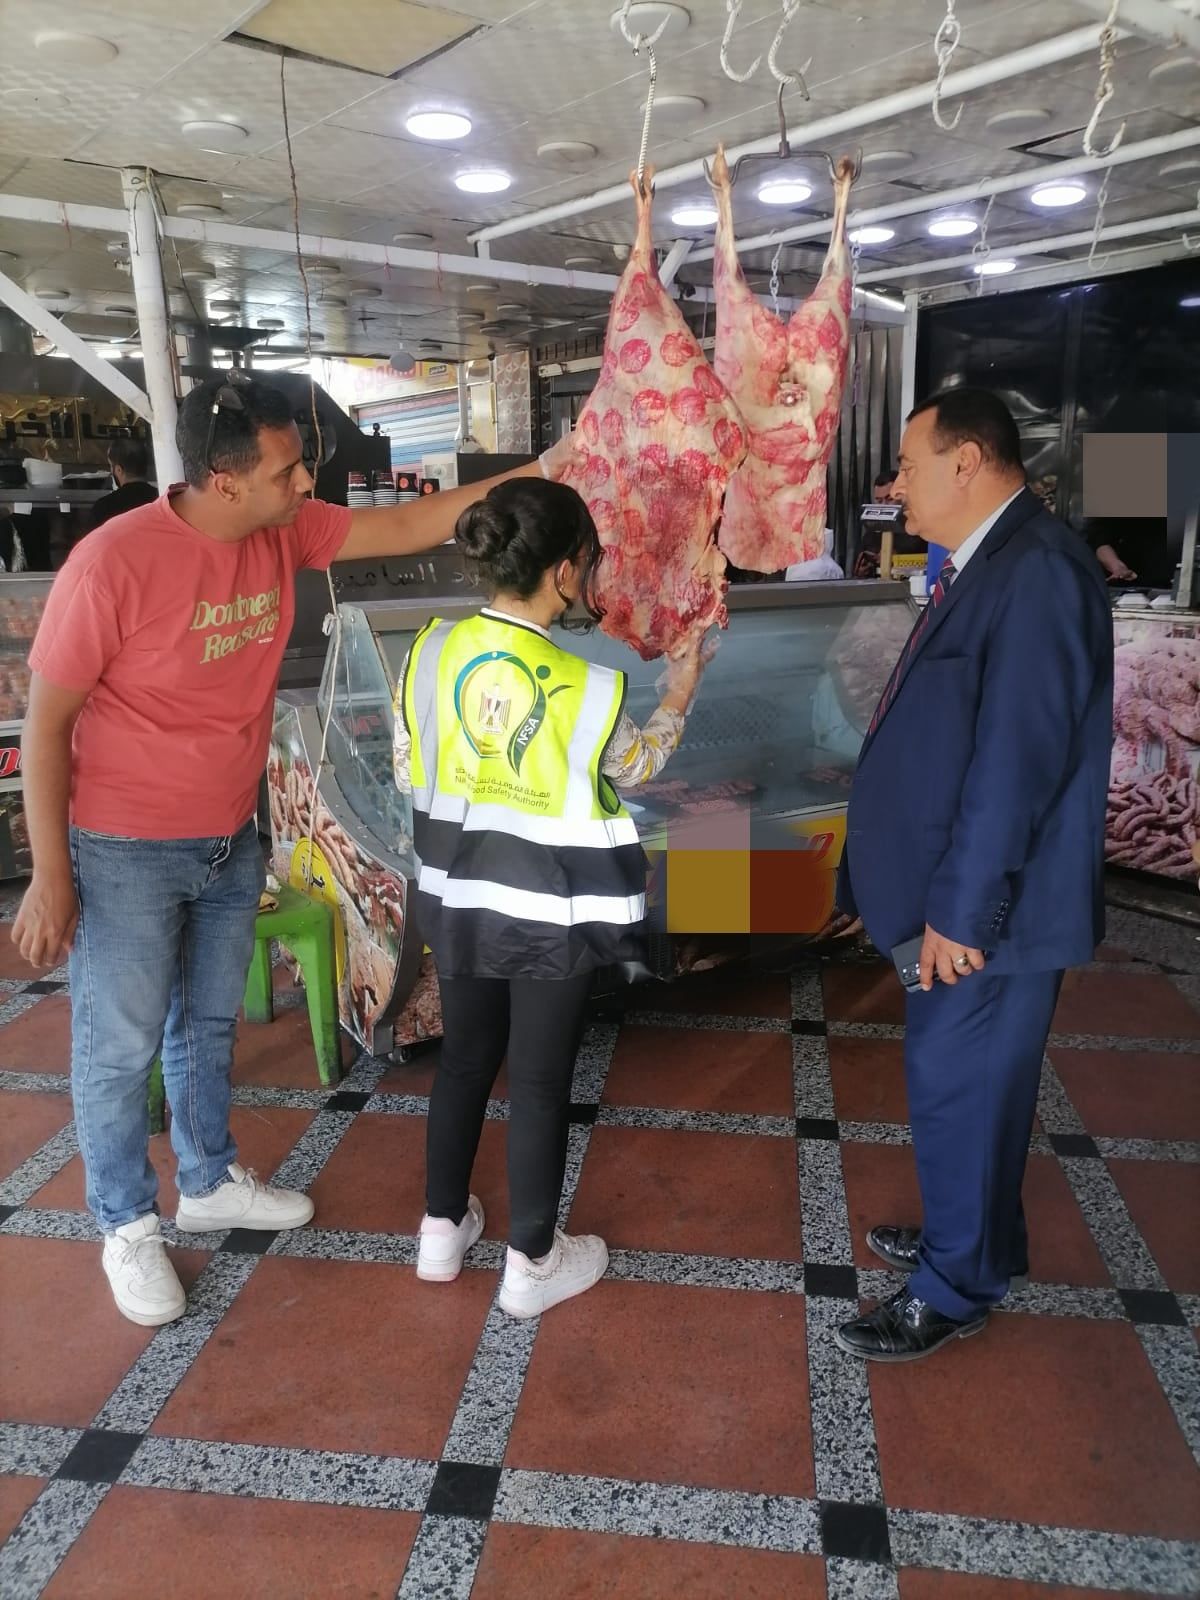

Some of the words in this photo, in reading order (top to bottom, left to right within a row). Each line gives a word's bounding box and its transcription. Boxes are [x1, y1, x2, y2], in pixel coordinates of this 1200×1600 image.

[517, 717, 539, 746] NFSA
[487, 786, 511, 798] Safety
[513, 793, 550, 810] Authority
